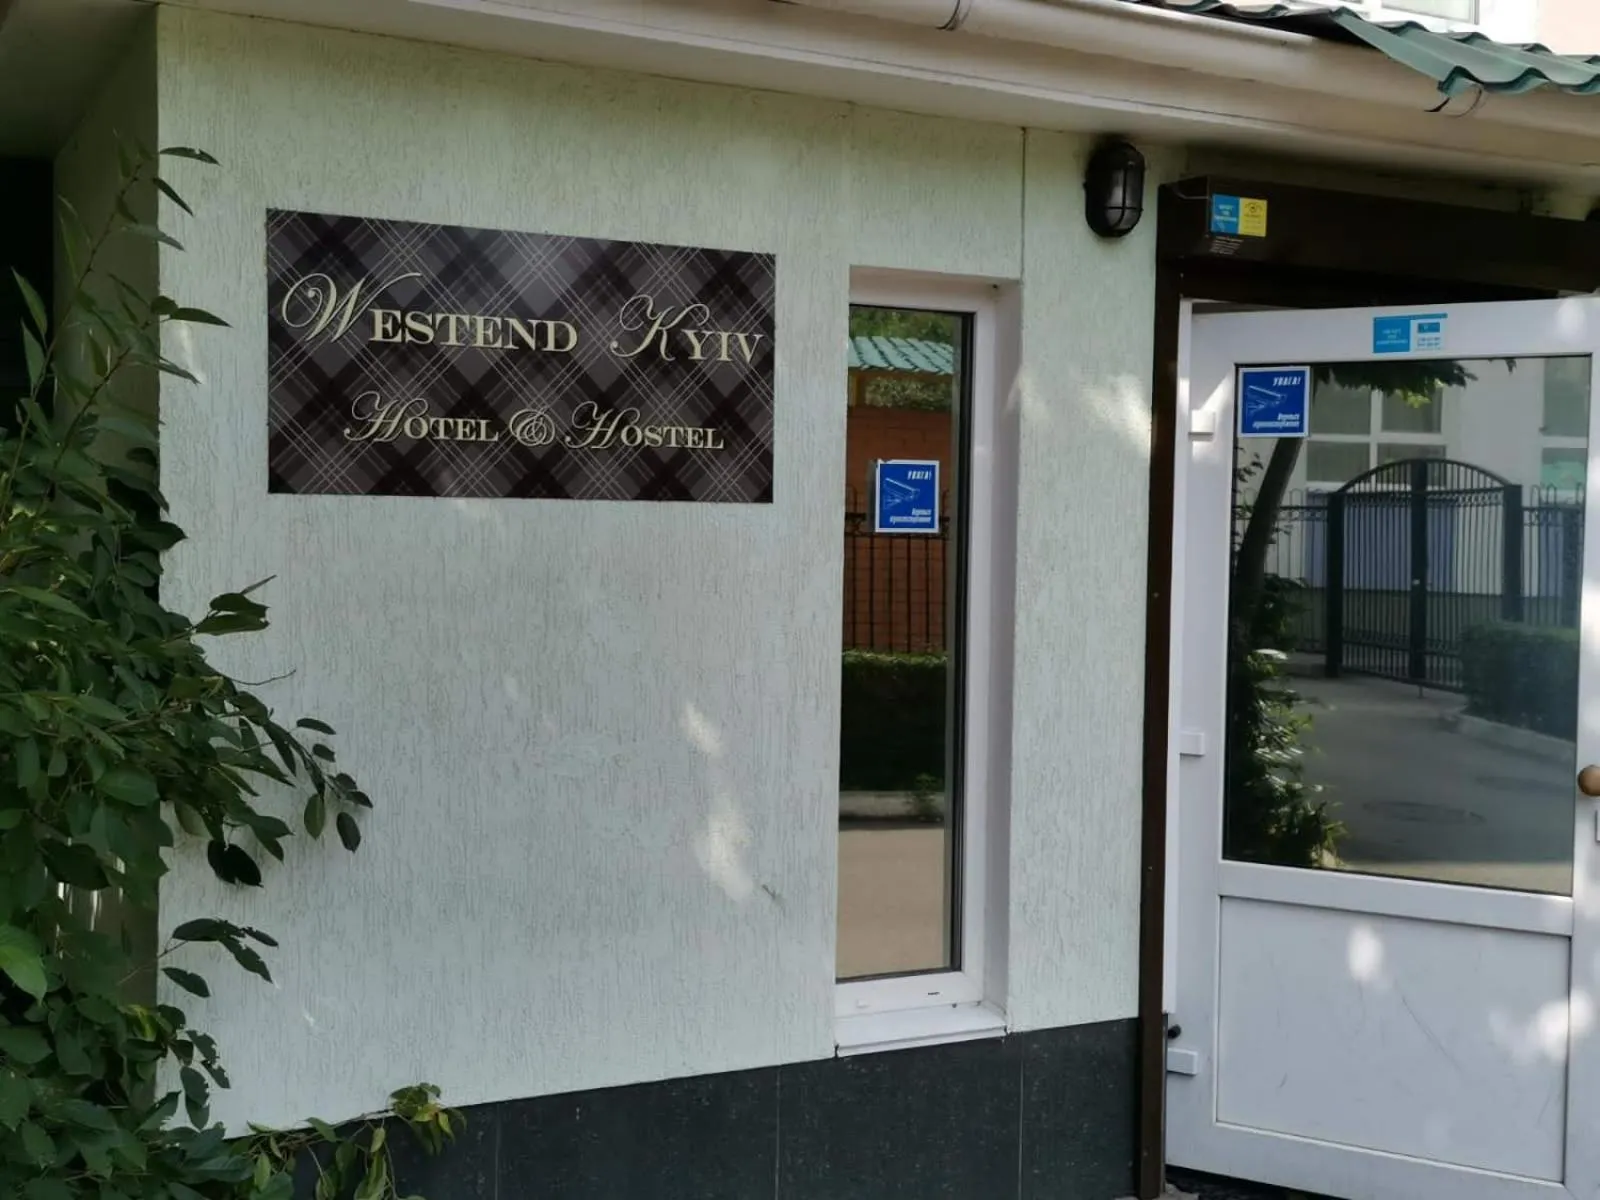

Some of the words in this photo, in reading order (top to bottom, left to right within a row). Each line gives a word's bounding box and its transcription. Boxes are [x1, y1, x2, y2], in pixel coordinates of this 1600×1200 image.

[281, 272, 579, 354] WESTEND
[609, 293, 765, 365] KYIV
[343, 390, 500, 444] HOTEL
[508, 408, 556, 448] &
[565, 400, 725, 451] HOSTEL
